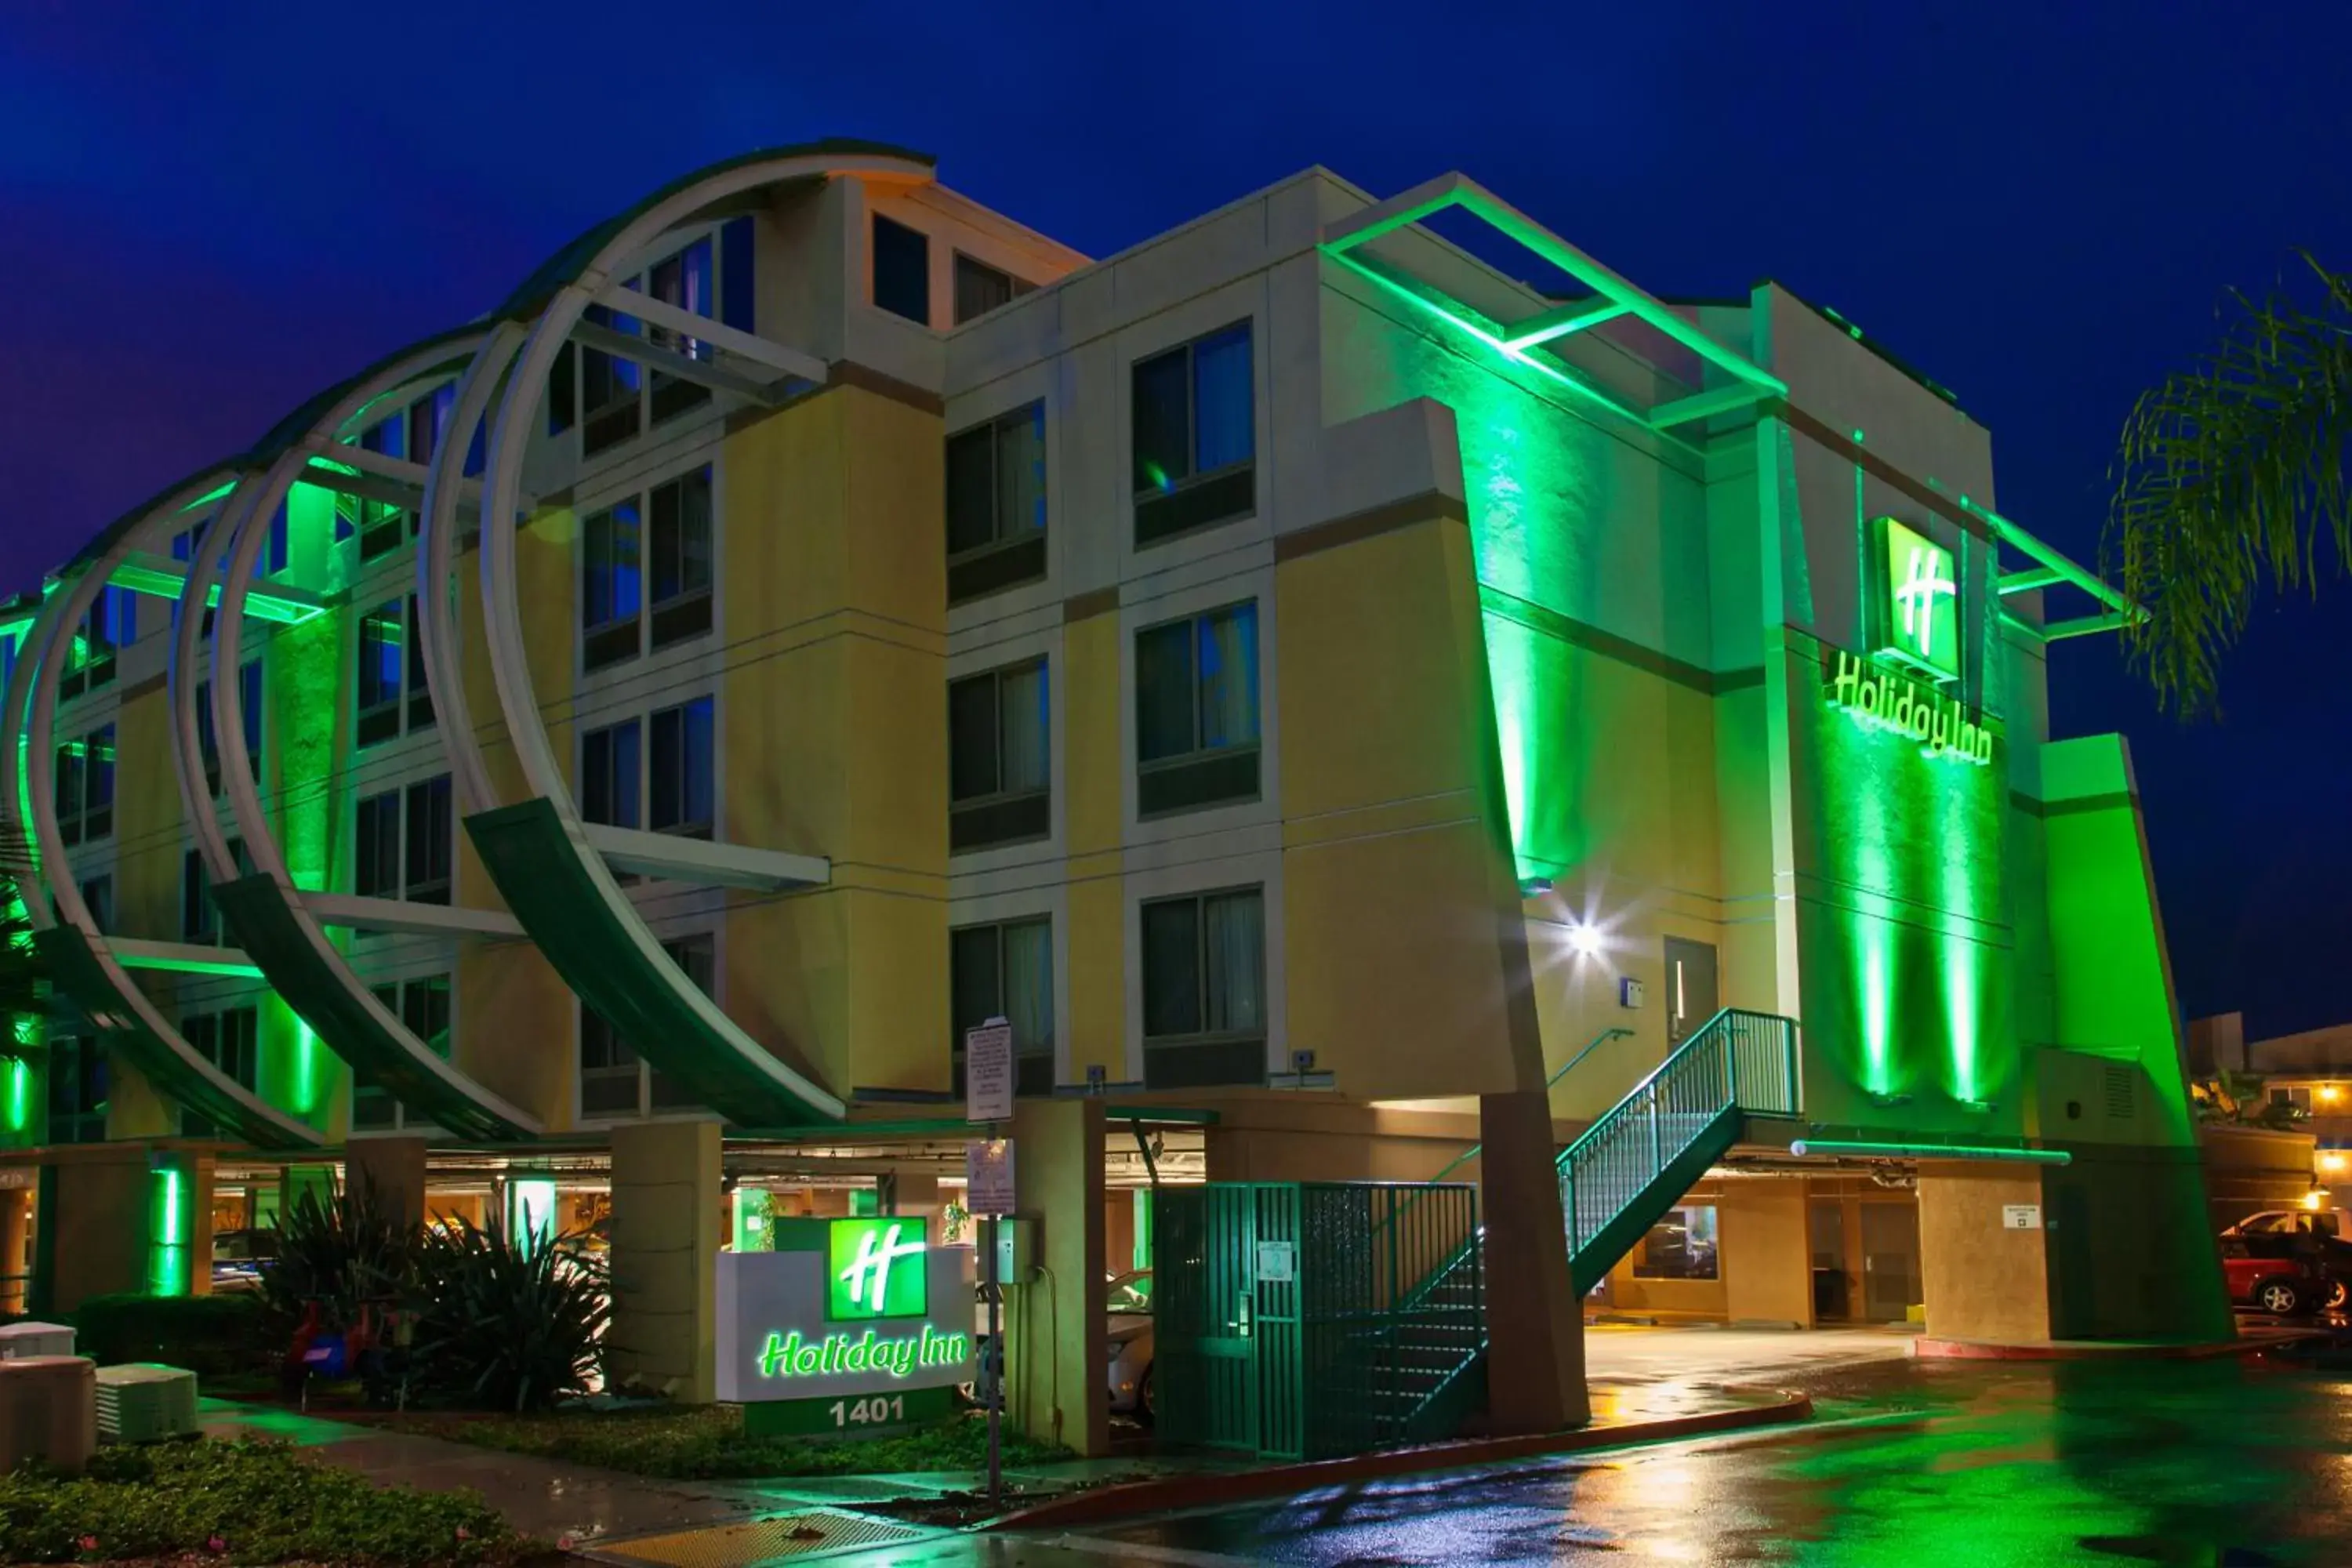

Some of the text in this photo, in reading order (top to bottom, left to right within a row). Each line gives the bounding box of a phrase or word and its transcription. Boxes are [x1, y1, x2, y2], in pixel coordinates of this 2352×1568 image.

[1896, 546, 1956, 656] H
[1835, 650, 1993, 764] Holiday Inn
[840, 1224, 927, 1312] H
[758, 1324, 967, 1377] Holiday Inn
[829, 1396, 905, 1427] 1401
